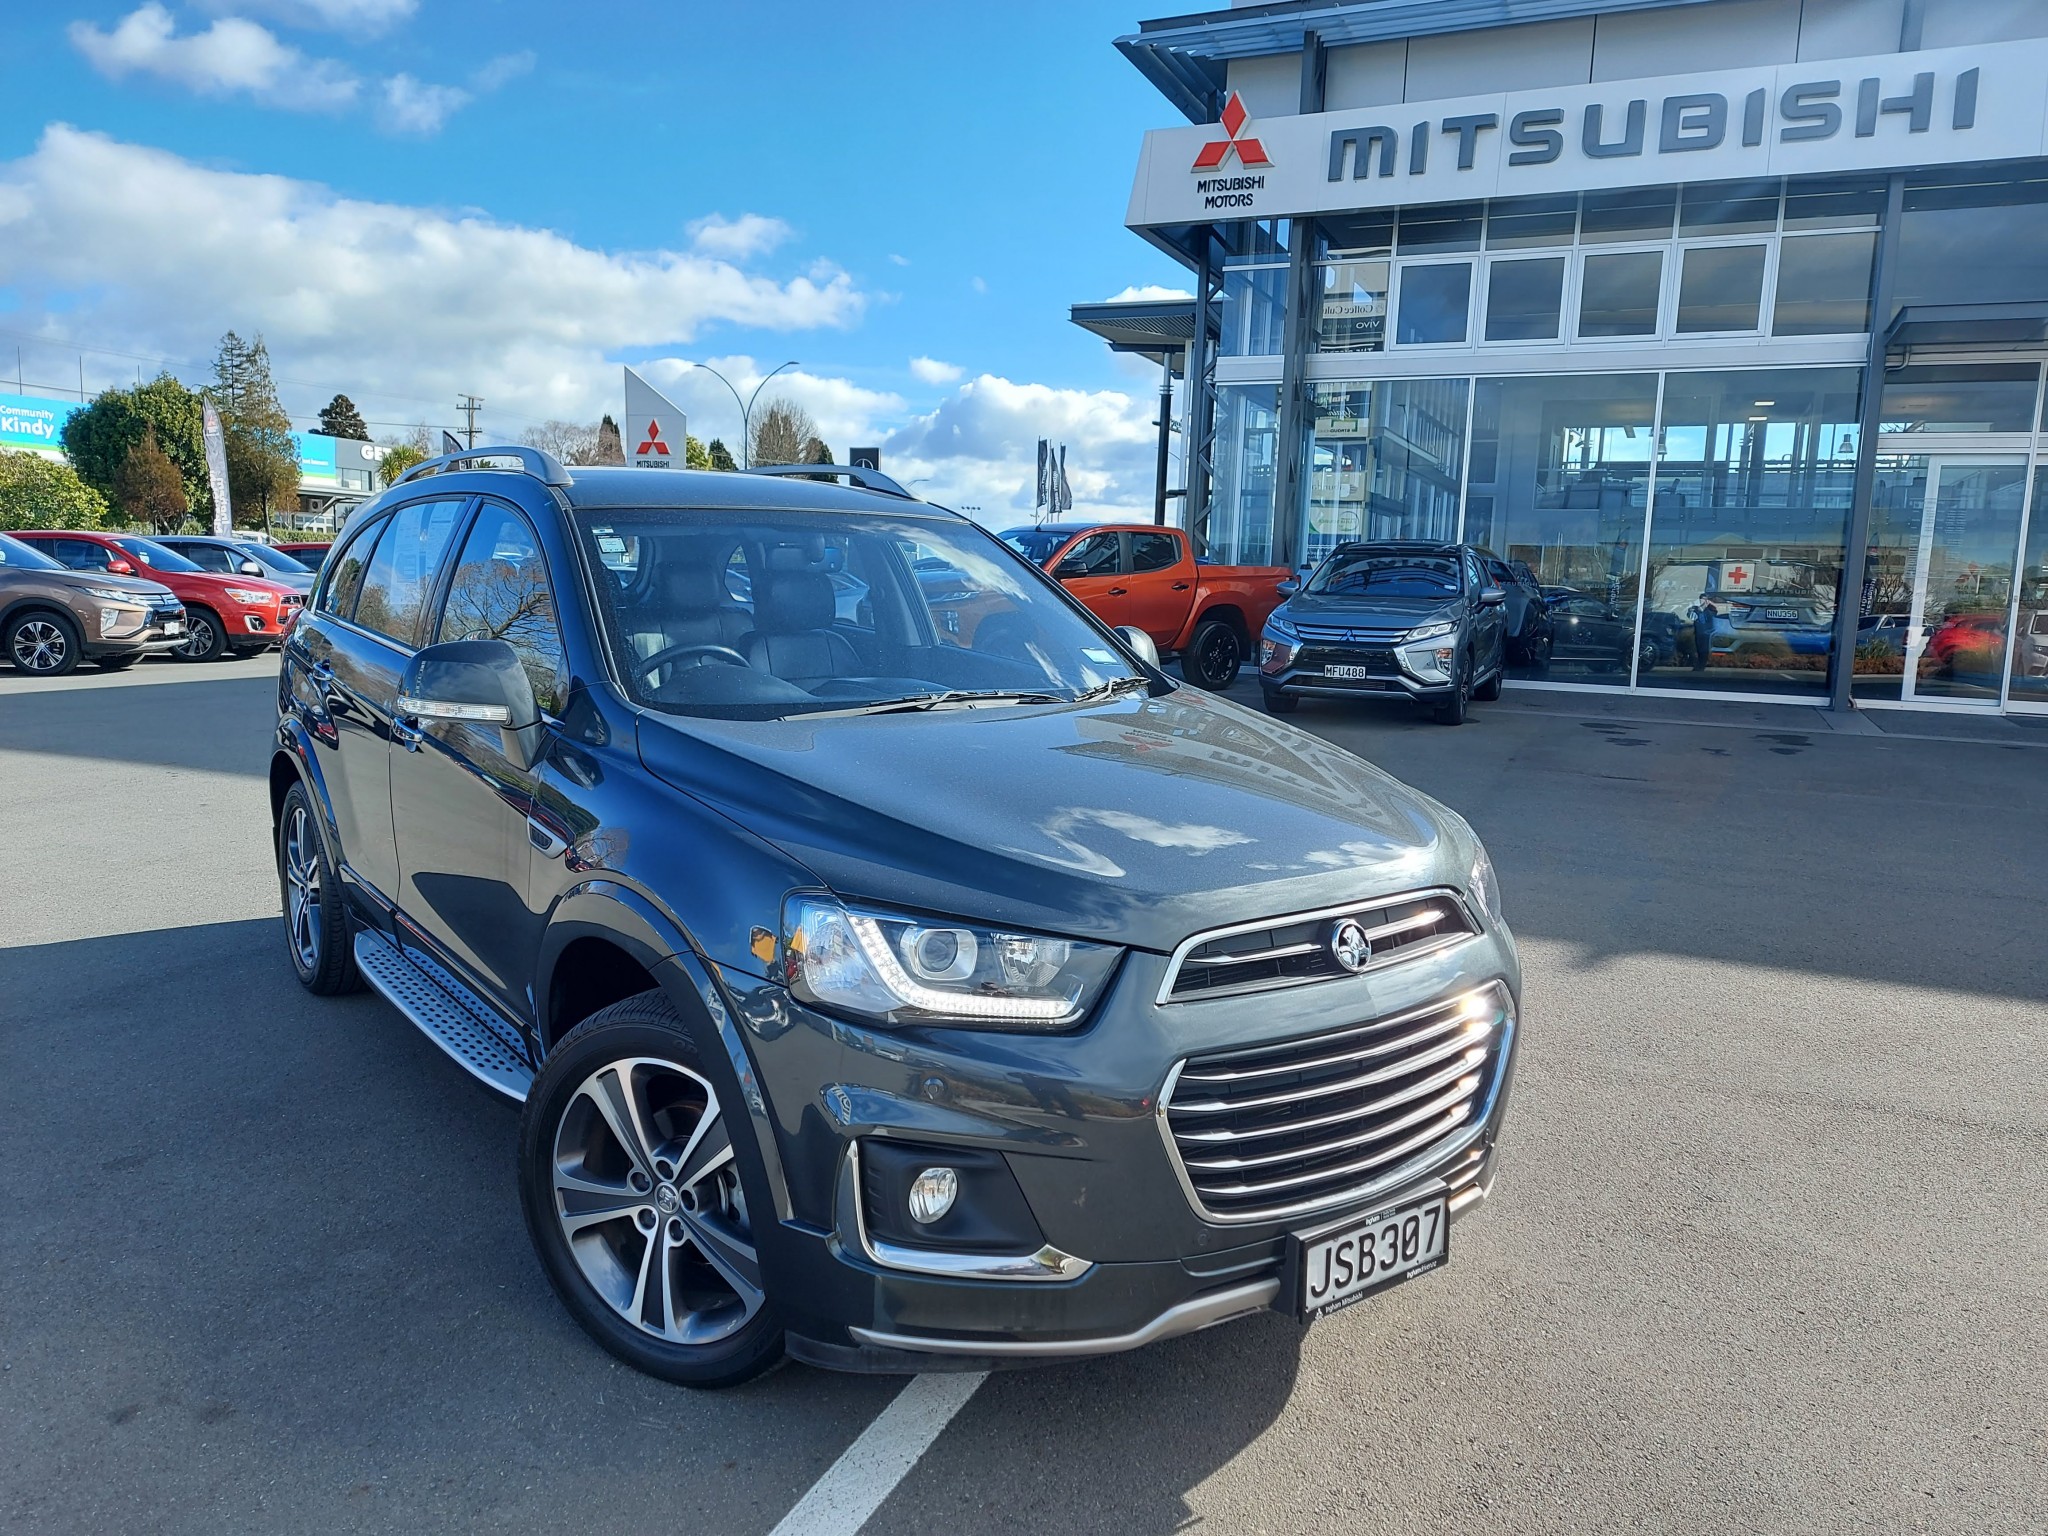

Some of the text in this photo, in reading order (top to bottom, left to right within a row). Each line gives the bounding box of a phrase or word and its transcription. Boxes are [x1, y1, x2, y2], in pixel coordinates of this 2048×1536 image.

[1328, 66, 1980, 182] MITSUBISHI
[1197, 175, 1265, 193] MITSUBISHI
[1204, 193, 1254, 209] MOTORS
[0, 404, 54, 421] Community
[1, 416, 55, 439] Kindy
[636, 460, 670, 468] MITSUBISHI
[1767, 609, 1797, 618] NNU356
[1326, 666, 1364, 677] MFU488
[1310, 1205, 1441, 1298] JSB307
